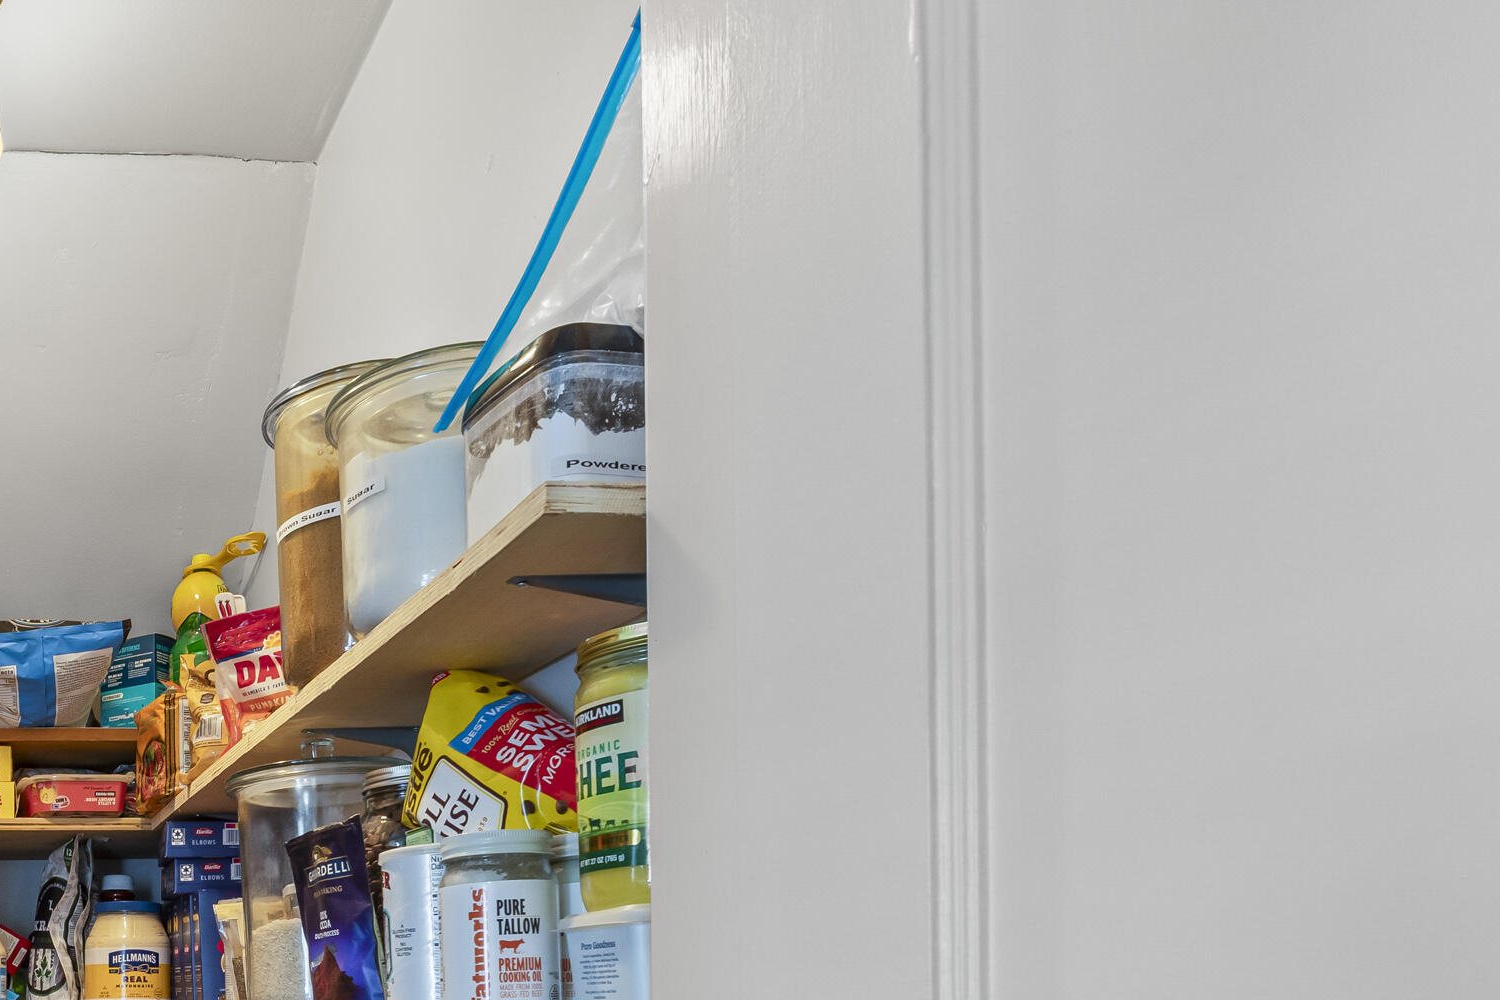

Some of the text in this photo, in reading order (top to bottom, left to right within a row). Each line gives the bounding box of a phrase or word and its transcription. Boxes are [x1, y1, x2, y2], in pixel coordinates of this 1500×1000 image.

[346, 483, 376, 506] Sugar
[301, 507, 337, 523] Sugar
[462, 717, 487, 745] BEST
[482, 714, 520, 754] 100% Real
[496, 899, 526, 916] PURE
[497, 918, 540, 935] TALLOW
[112, 952, 157, 964] HELLMANN'S
[500, 957, 542, 971] PREMIUM
[123, 975, 148, 984] REAL
[500, 971, 542, 983] COOKING OIL
